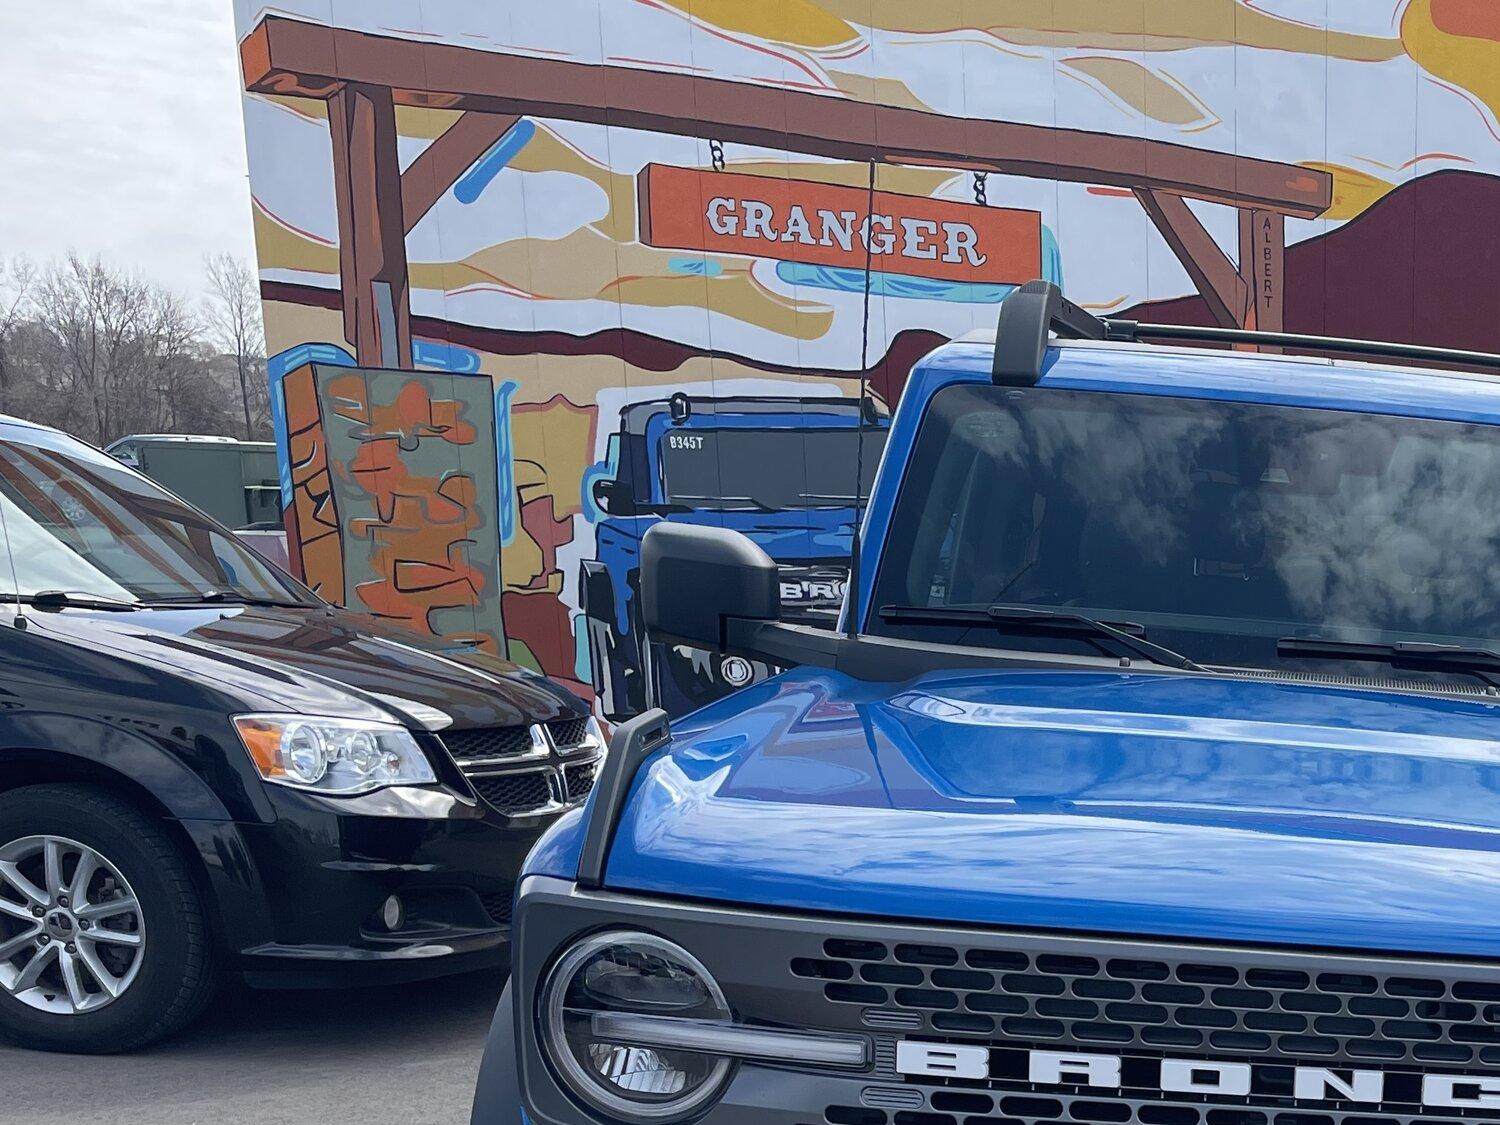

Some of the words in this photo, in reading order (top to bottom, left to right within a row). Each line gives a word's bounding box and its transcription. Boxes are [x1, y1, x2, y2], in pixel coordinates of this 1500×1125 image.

[705, 196, 987, 267] GRANGER
[1262, 217, 1273, 308] ALBERT
[669, 435, 704, 450] B345T
